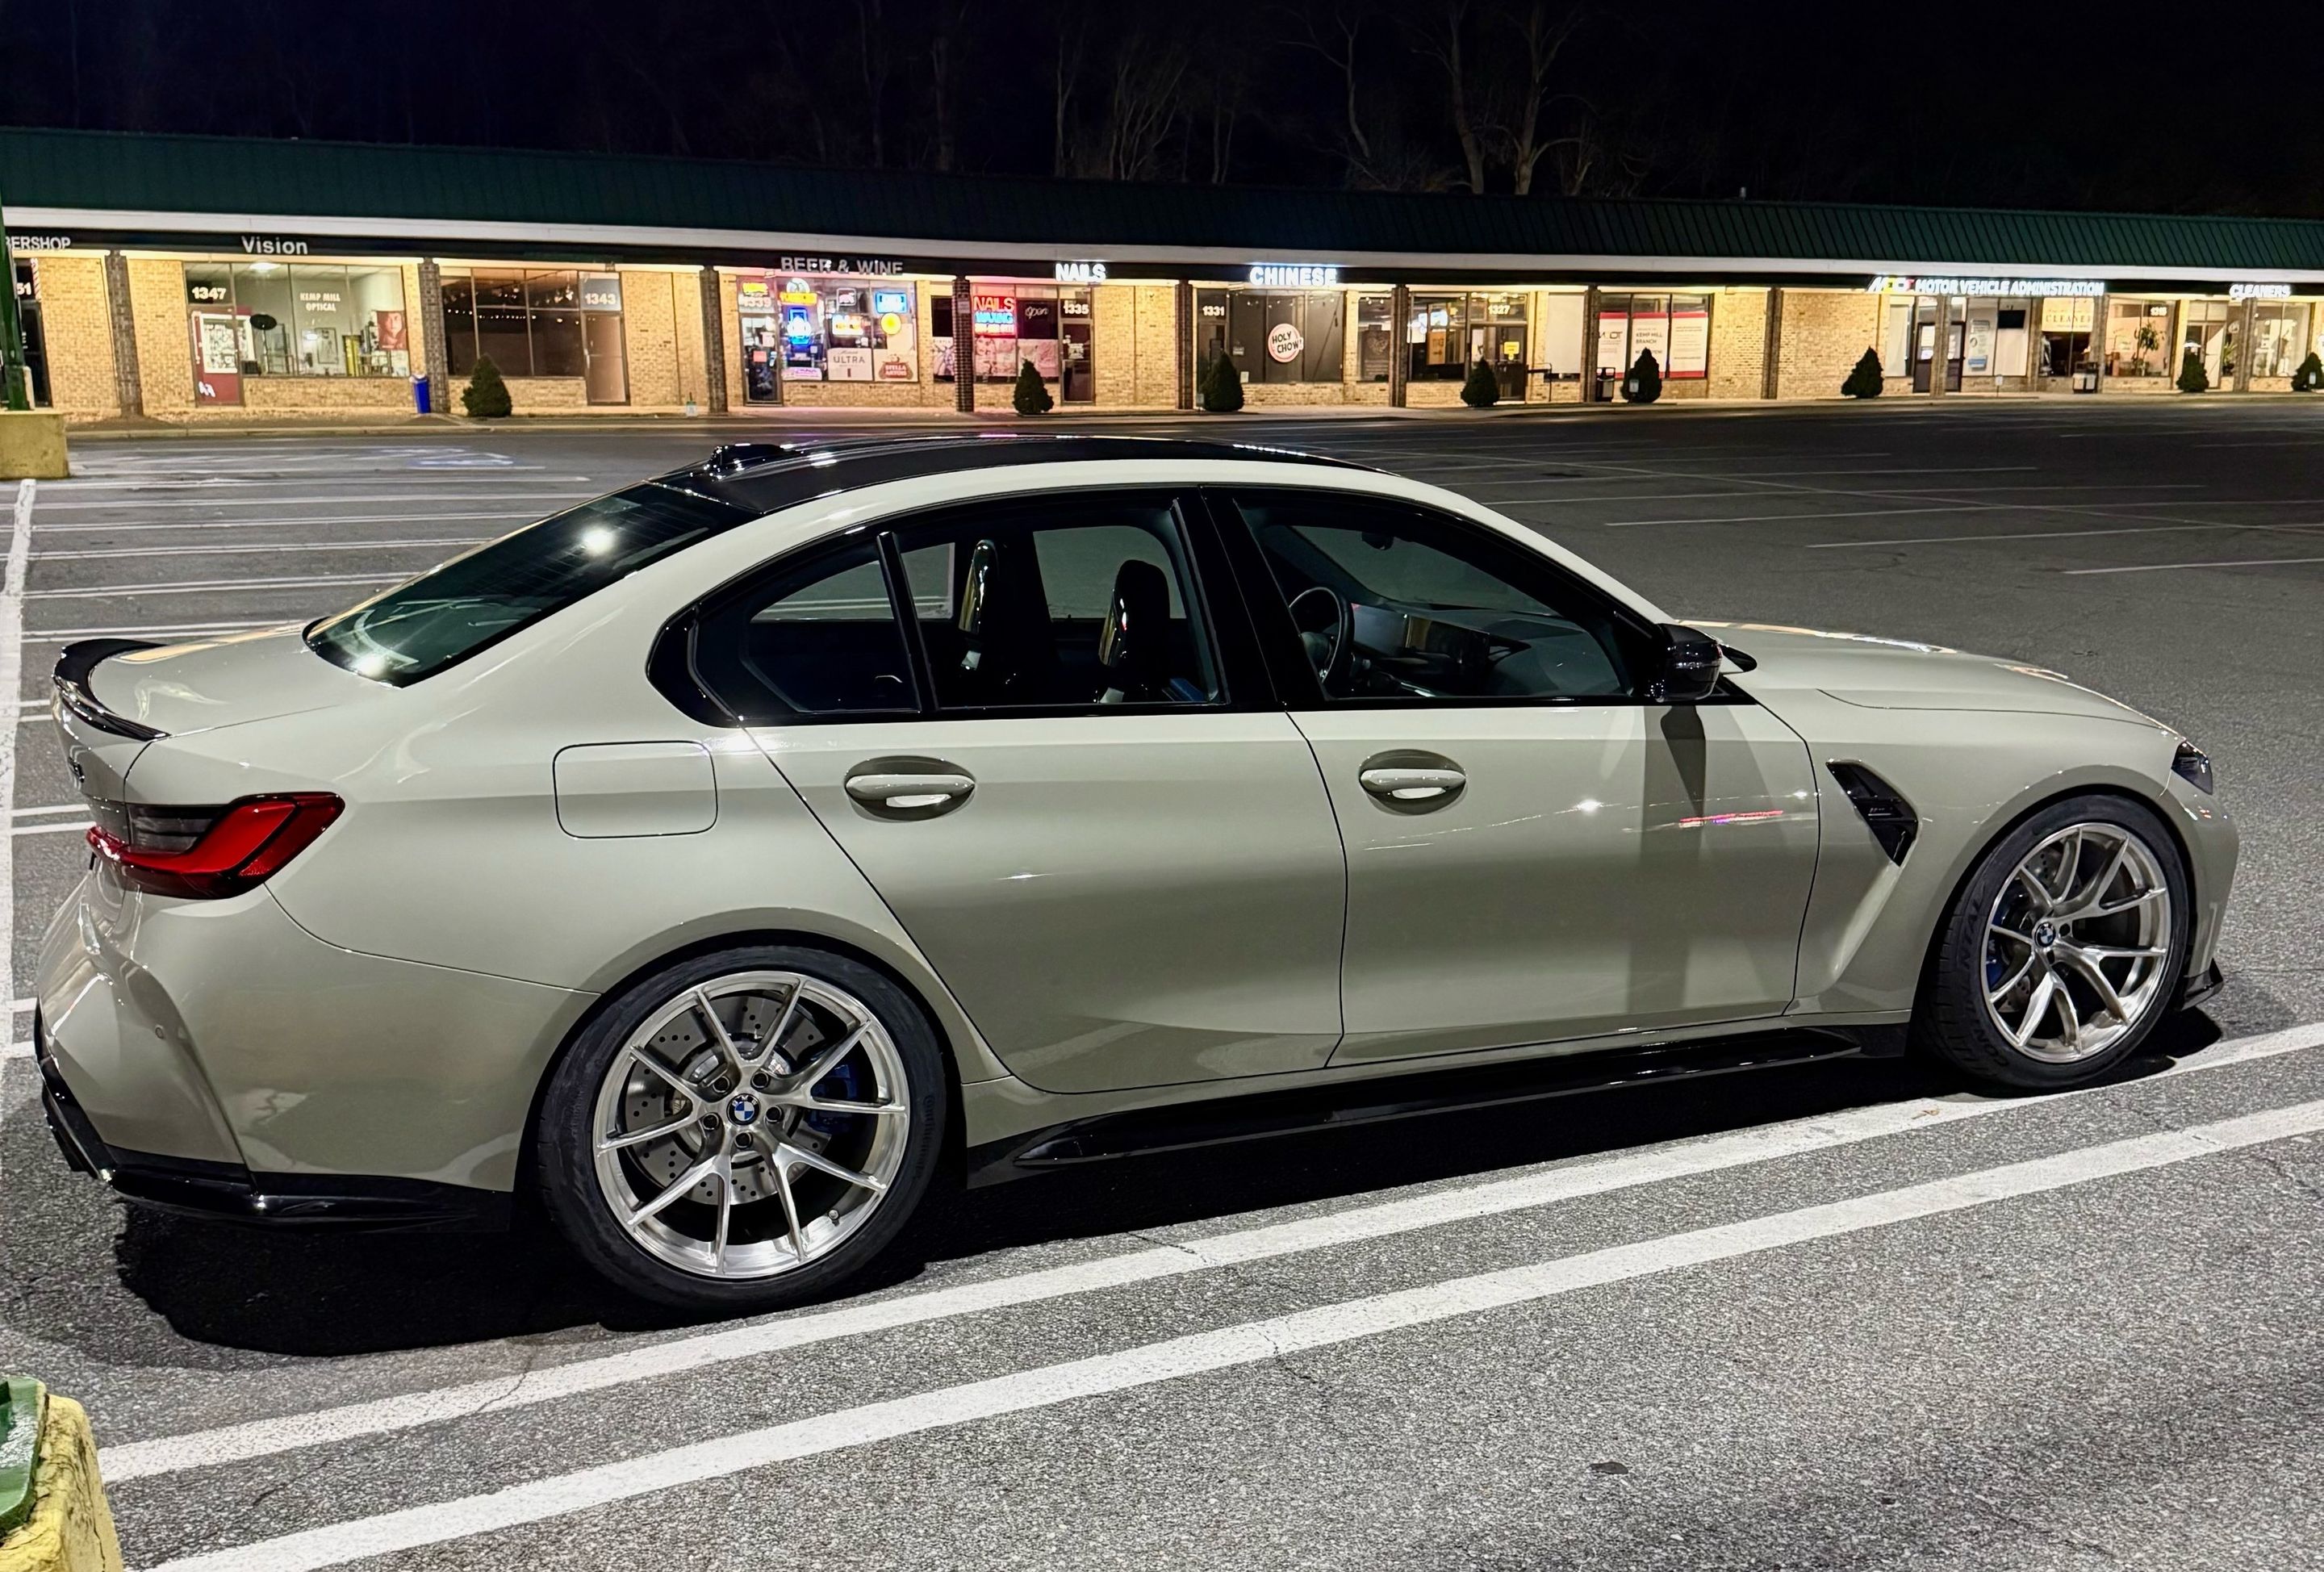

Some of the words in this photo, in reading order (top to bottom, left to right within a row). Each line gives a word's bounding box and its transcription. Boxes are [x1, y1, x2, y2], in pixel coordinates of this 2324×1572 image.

[241, 236, 307, 254] Vision
[780, 257, 831, 273] BEER
[838, 259, 849, 274] &
[856, 259, 903, 275] WINE
[1055, 263, 1107, 282] NAILS
[1249, 266, 1337, 286] CHINESE
[192, 287, 226, 299] 1347
[1915, 278, 1959, 295] MOTOR
[1959, 279, 2009, 295] VEHICLE
[2009, 281, 2105, 296] ADMINISTRATION
[2230, 284, 2291, 299] CLEANERS
[300, 293, 320, 301] KEMP
[323, 293, 341, 301] MILL
[584, 293, 616, 305] 1343
[973, 296, 1015, 312] NAILS
[306, 303, 336, 311] OPTICAL
[1064, 300, 1089, 315] 1335
[1202, 305, 1225, 316] 1331
[1272, 331, 1291, 344] HOLY
